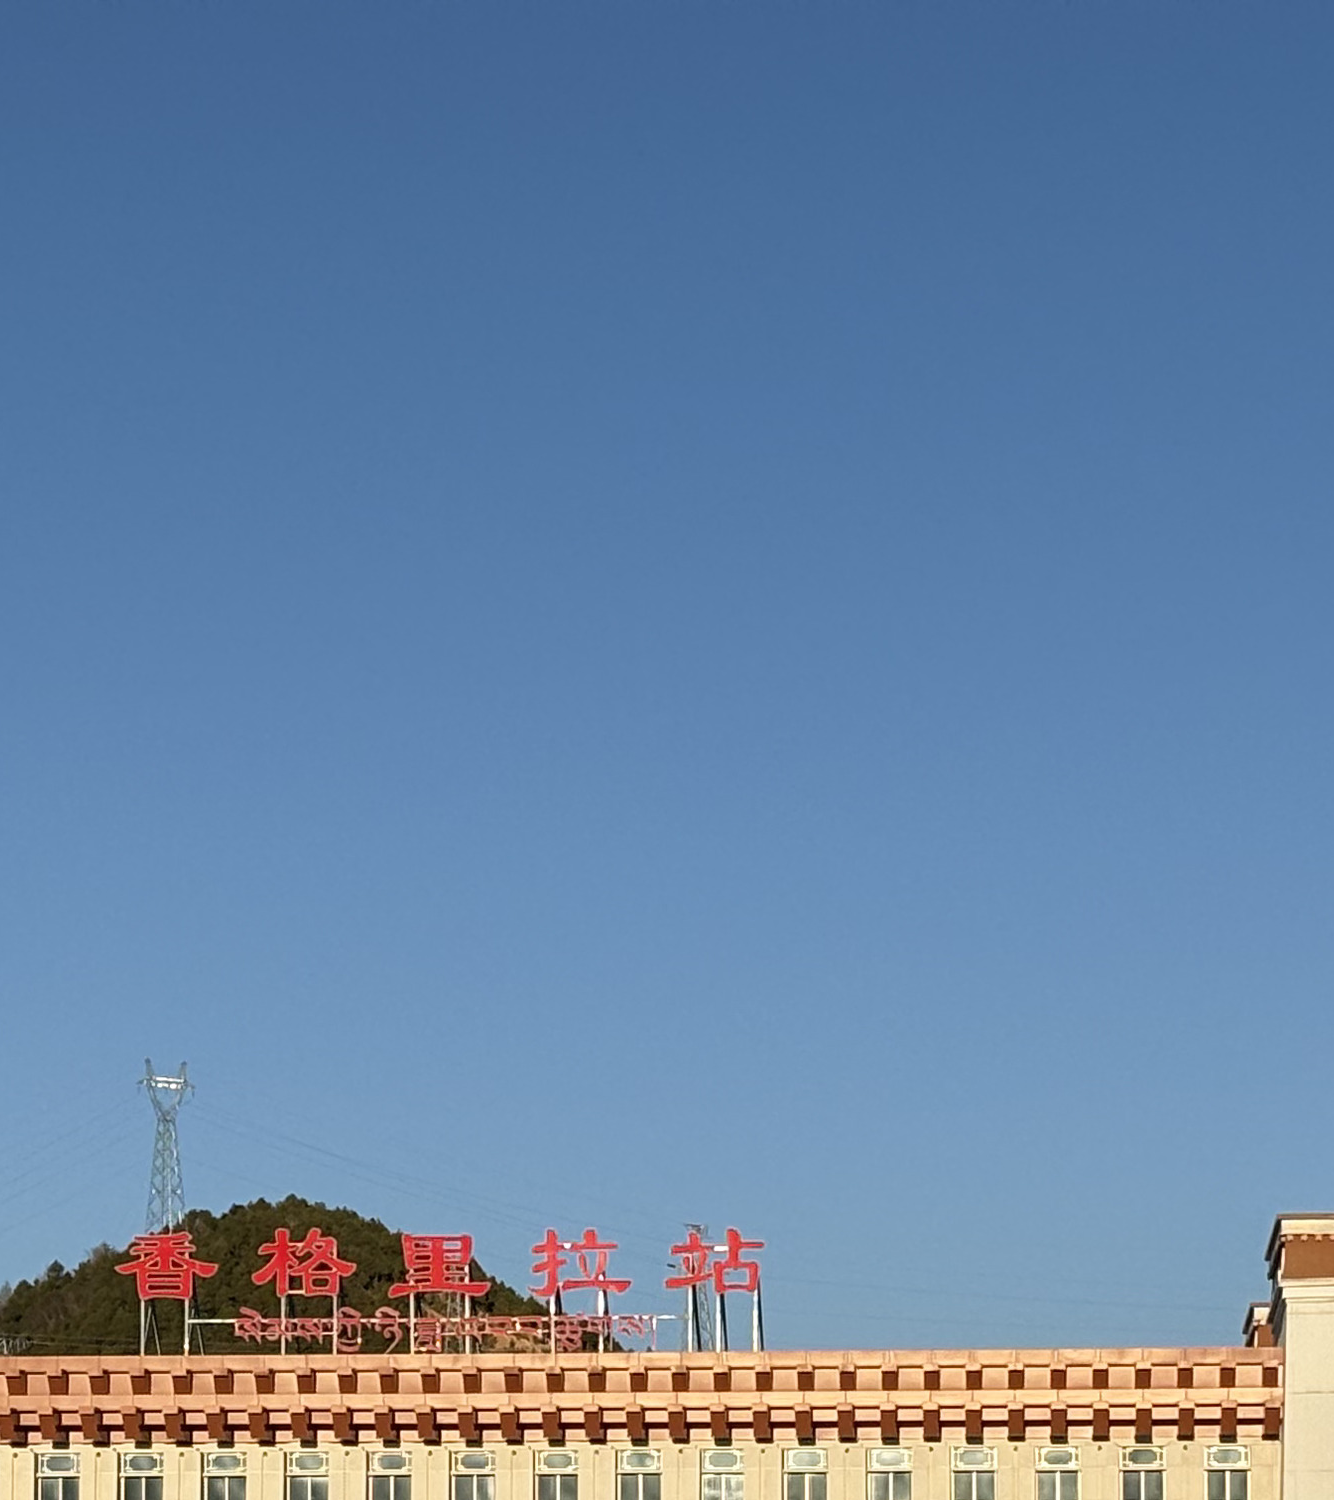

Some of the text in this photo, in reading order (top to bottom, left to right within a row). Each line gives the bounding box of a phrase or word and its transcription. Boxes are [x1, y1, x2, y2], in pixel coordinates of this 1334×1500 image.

[114, 1227, 765, 1301] 香格里拉站
